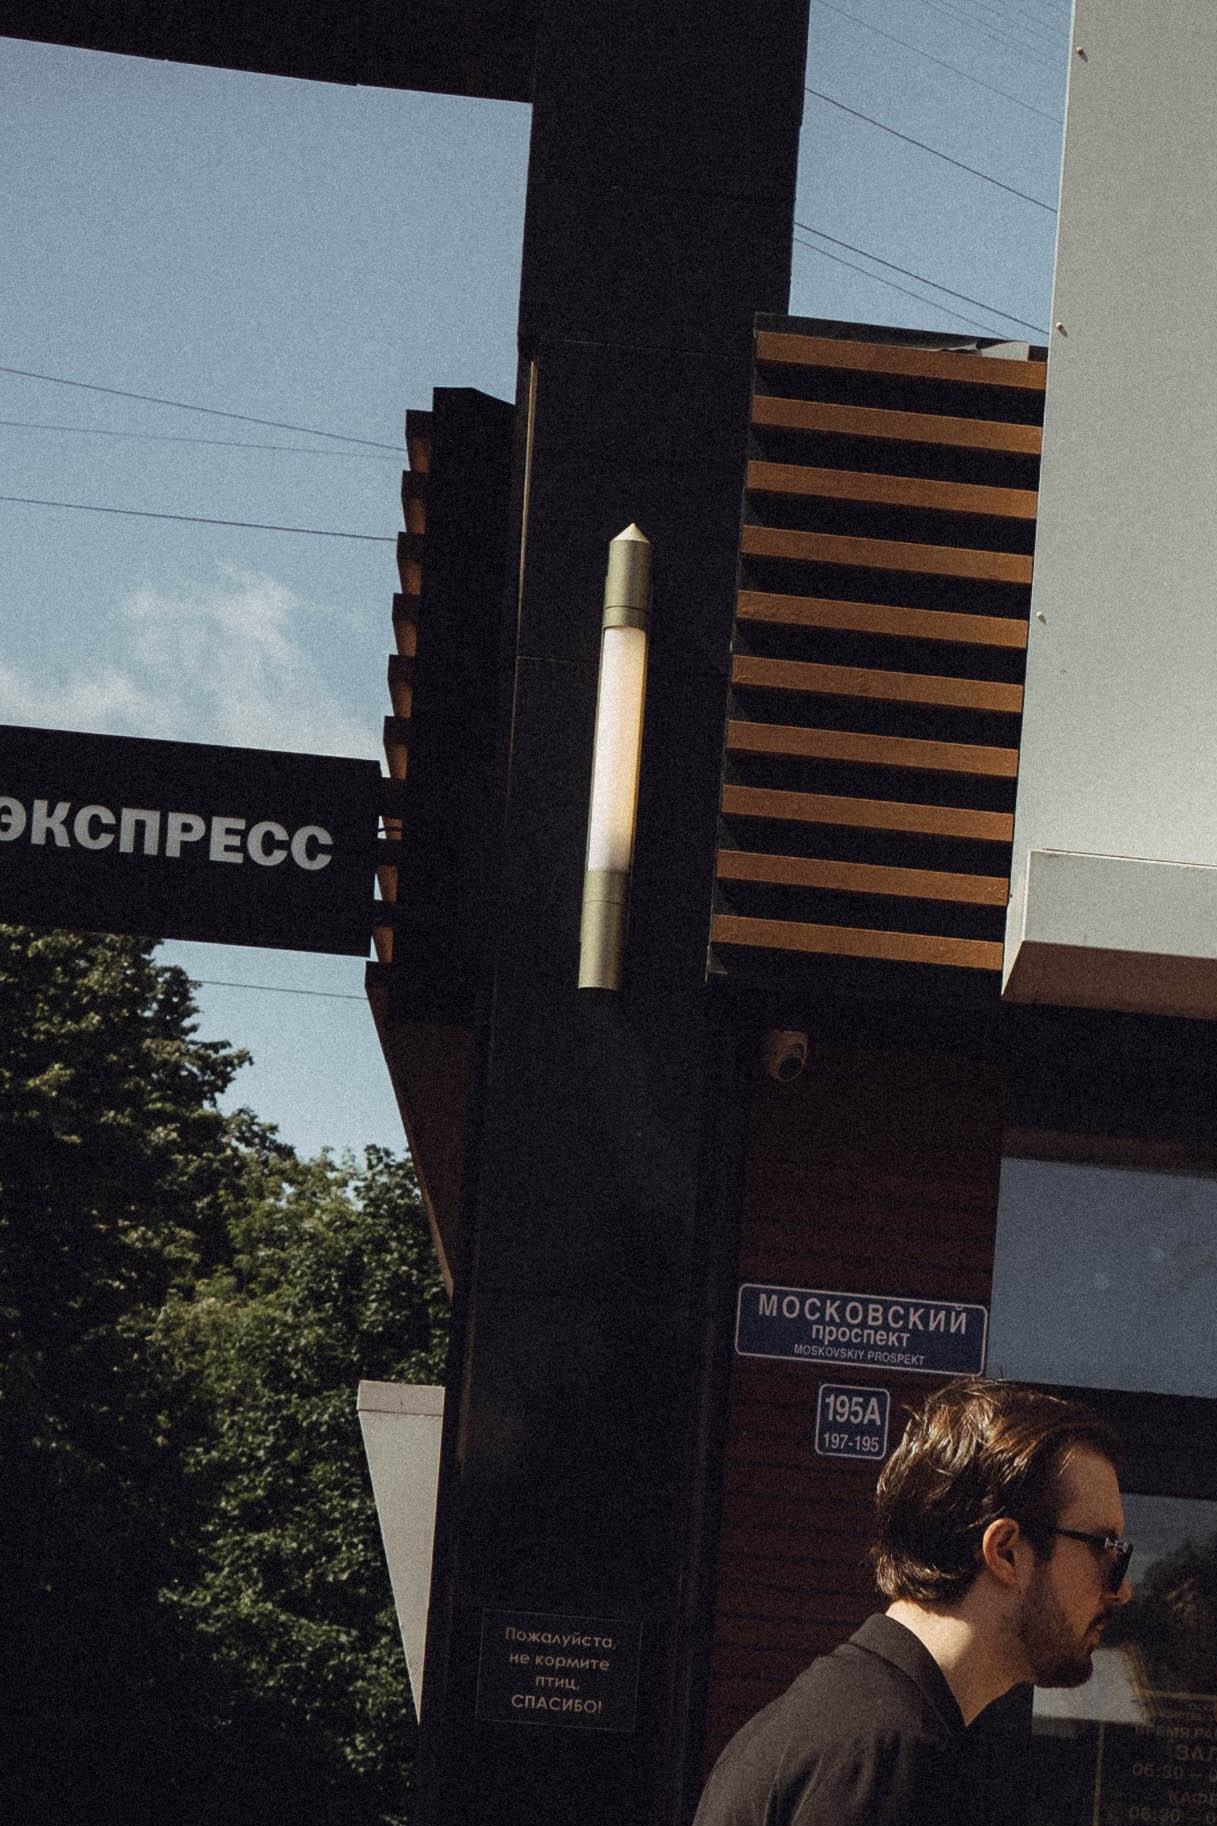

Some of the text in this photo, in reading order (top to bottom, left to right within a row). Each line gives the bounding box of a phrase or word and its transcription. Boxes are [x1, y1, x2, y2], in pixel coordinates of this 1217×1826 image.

[0, 795, 334, 871] ЭКСПРЕСС
[759, 1293, 967, 1335] МОСКОВСКИЙ
[811, 1324, 911, 1347] проспект
[794, 1344, 925, 1365] MOSKOVSKIY PROSPEKT
[825, 1394, 881, 1425] 195А
[823, 1433, 879, 1453] 197-195
[508, 1653, 610, 1671] не кормите
[511, 1693, 603, 1714] СПАСИБО!
